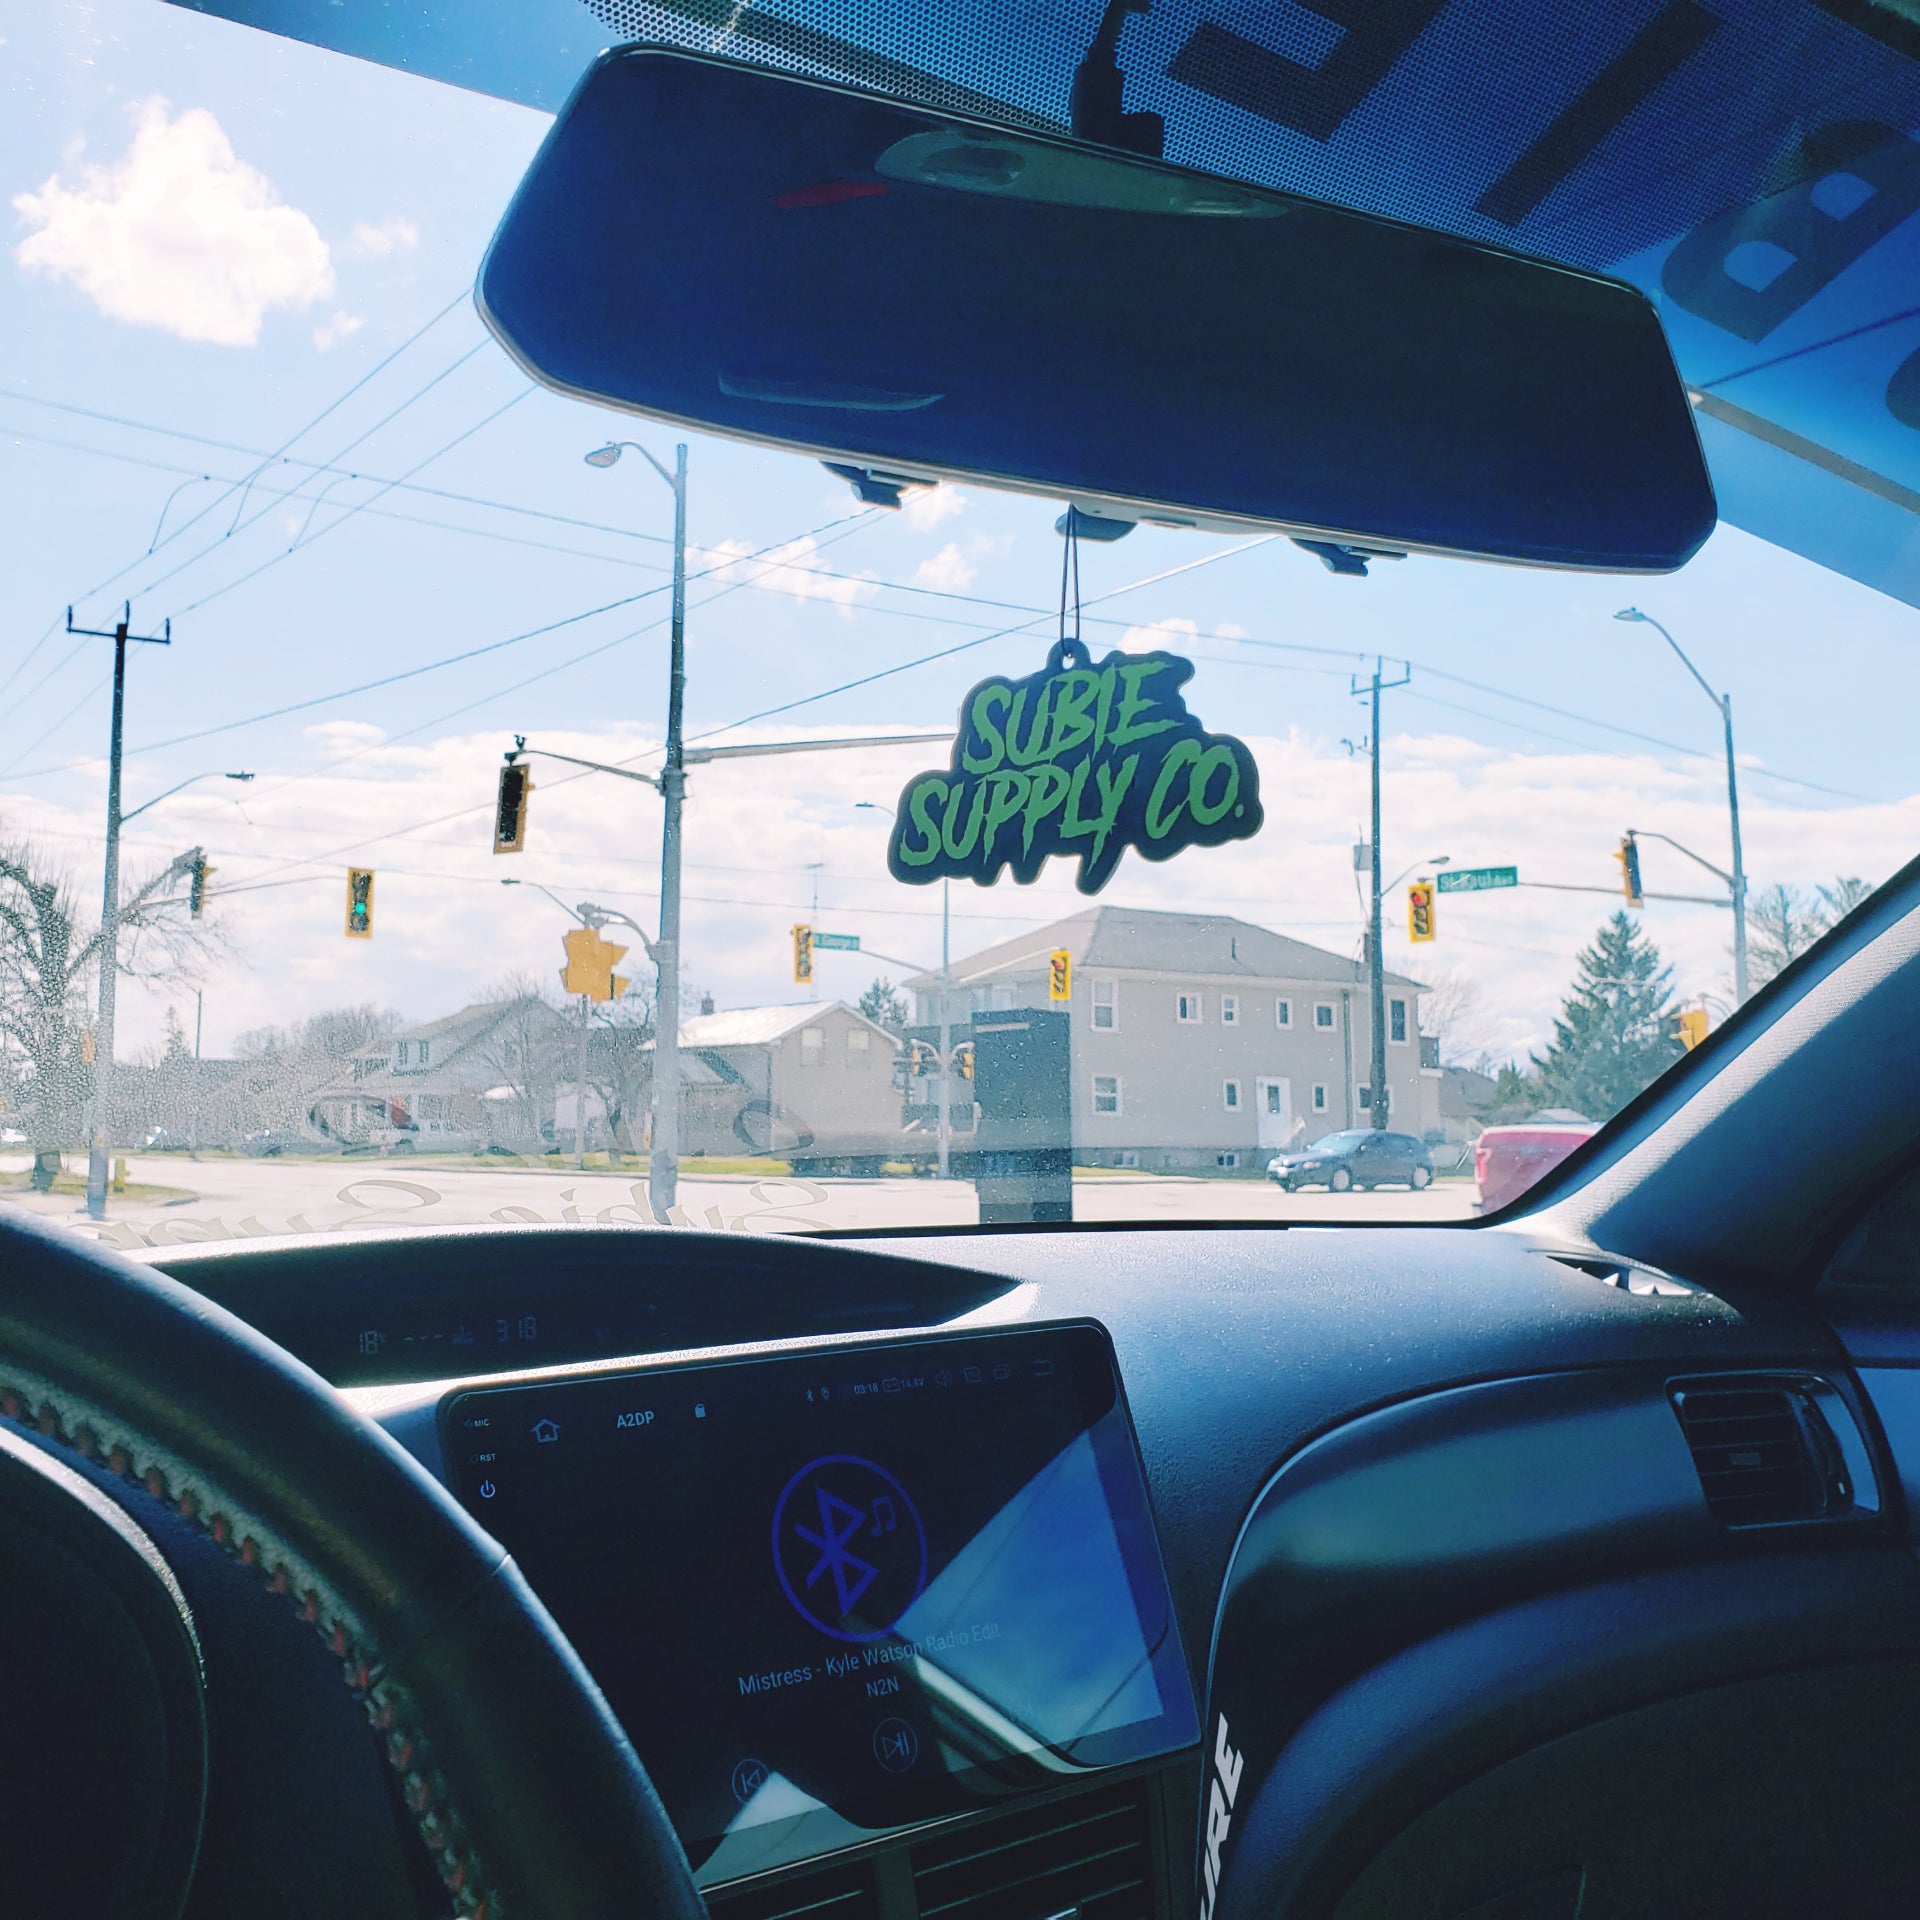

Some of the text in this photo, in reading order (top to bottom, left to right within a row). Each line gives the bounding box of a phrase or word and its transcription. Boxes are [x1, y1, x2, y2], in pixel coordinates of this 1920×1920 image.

[962, 660, 1185, 775] SUBIE
[899, 738, 1244, 875] SUPPLY CO.
[474, 1418, 491, 1427] MIC
[617, 1410, 655, 1429] A2DP
[480, 1453, 496, 1462] RST
[738, 1665, 812, 1696] Mistress
[825, 1654, 860, 1678] Kyle
[862, 1640, 923, 1666] Watson
[926, 1630, 970, 1653] Radio
[865, 1675, 900, 1697] N2N
